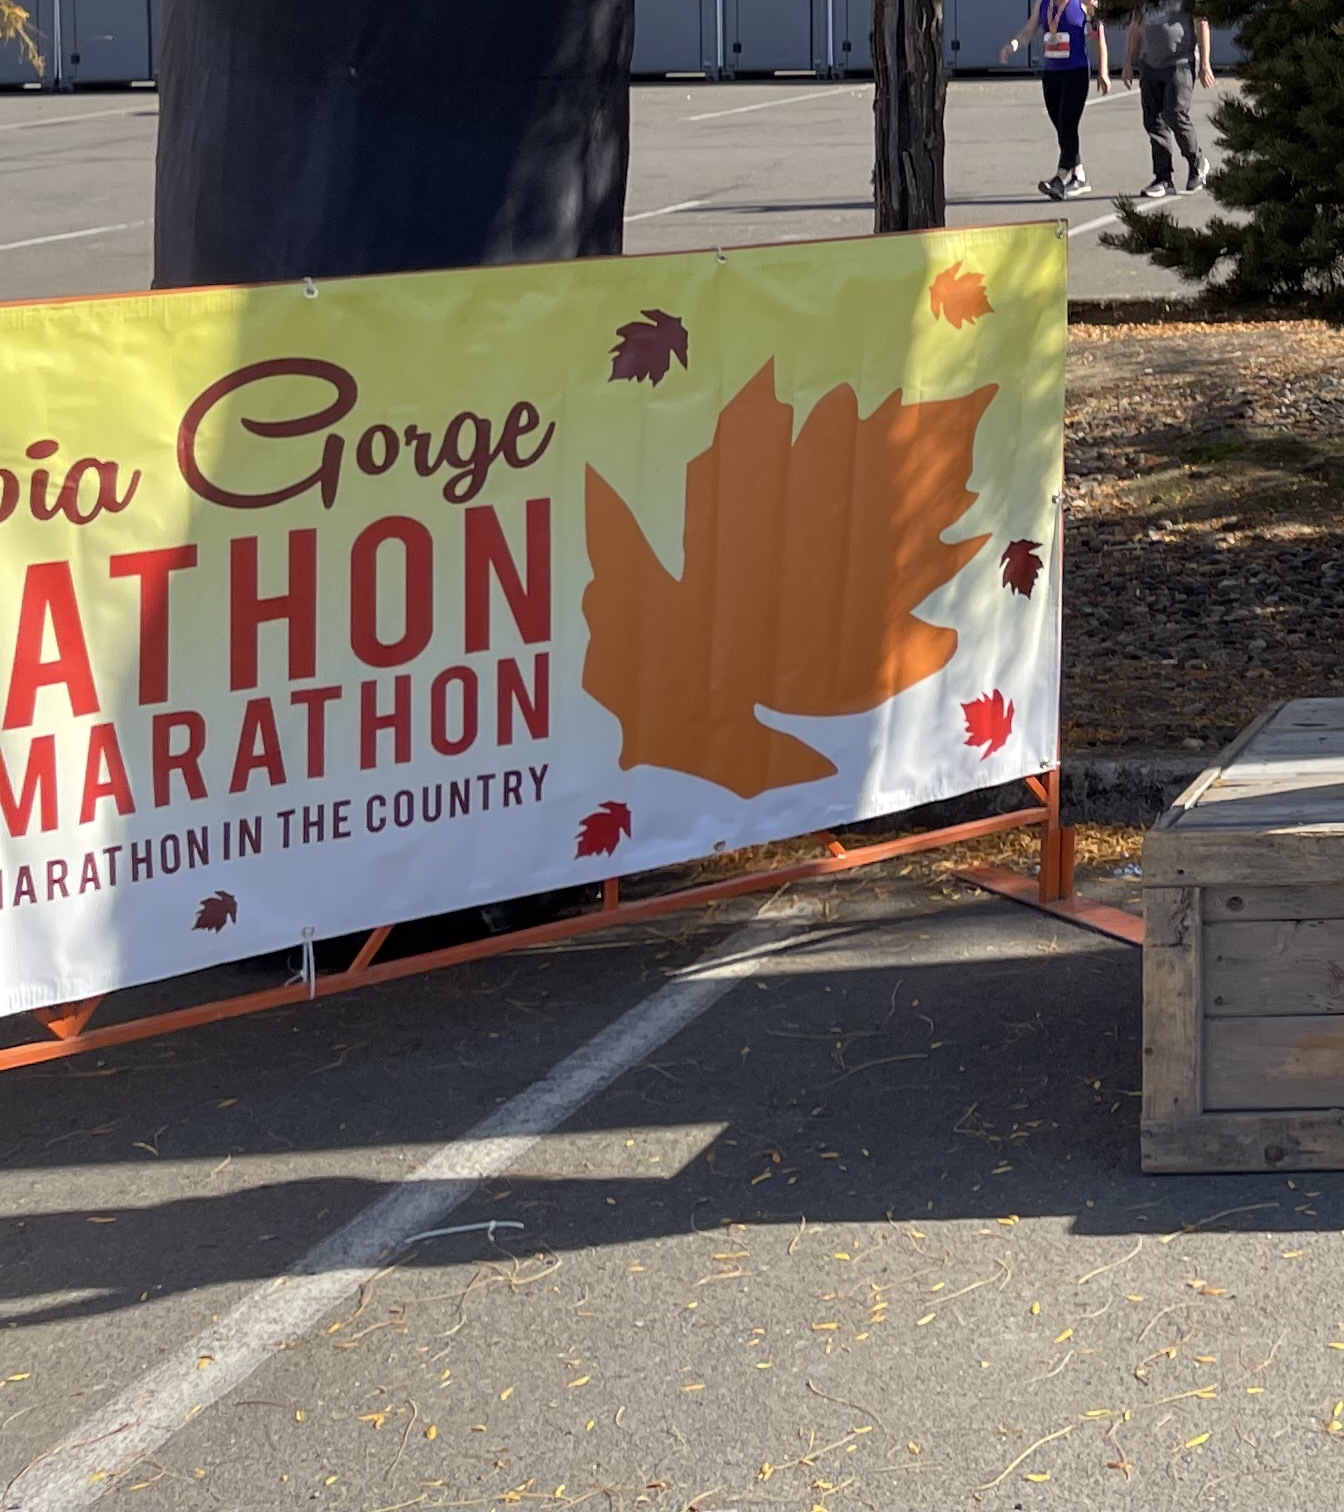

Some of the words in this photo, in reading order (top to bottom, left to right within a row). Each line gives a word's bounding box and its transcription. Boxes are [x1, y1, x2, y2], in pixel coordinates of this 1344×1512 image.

[177, 357, 556, 509] Gorge
[2, 497, 552, 731] ATHON
[0, 825, 209, 909] ARATHON
[223, 815, 262, 861] IN
[277, 798, 352, 850] THE
[366, 763, 550, 833] COUNTRY
